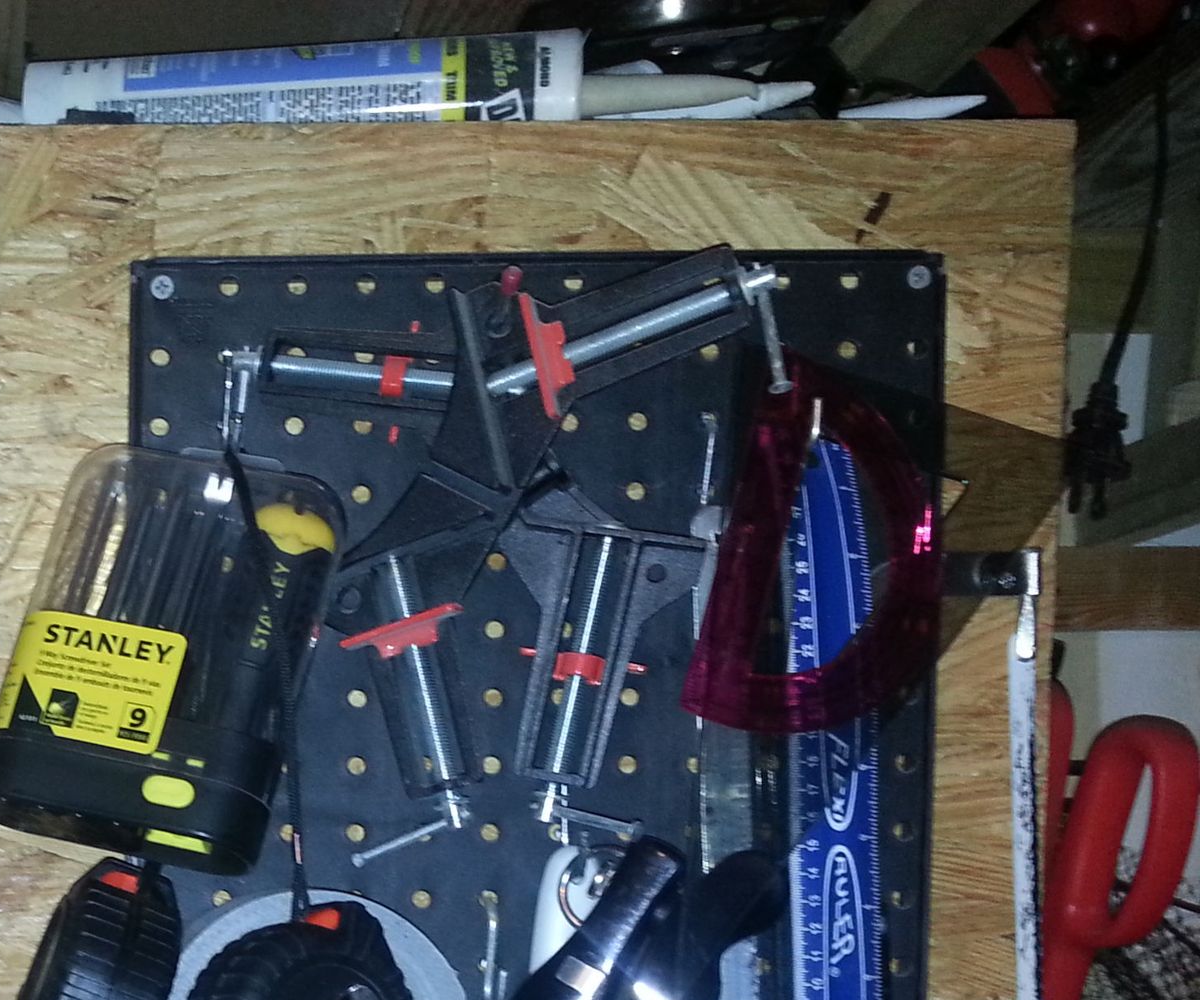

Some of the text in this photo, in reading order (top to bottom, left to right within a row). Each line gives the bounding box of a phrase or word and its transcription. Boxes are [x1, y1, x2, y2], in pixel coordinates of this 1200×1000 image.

[43, 623, 175, 665] STANLEY
[250, 561, 290, 651] STALEY
[128, 707, 147, 728] 9
[827, 732, 851, 824] FLEXI
[829, 856, 855, 966] RULER
